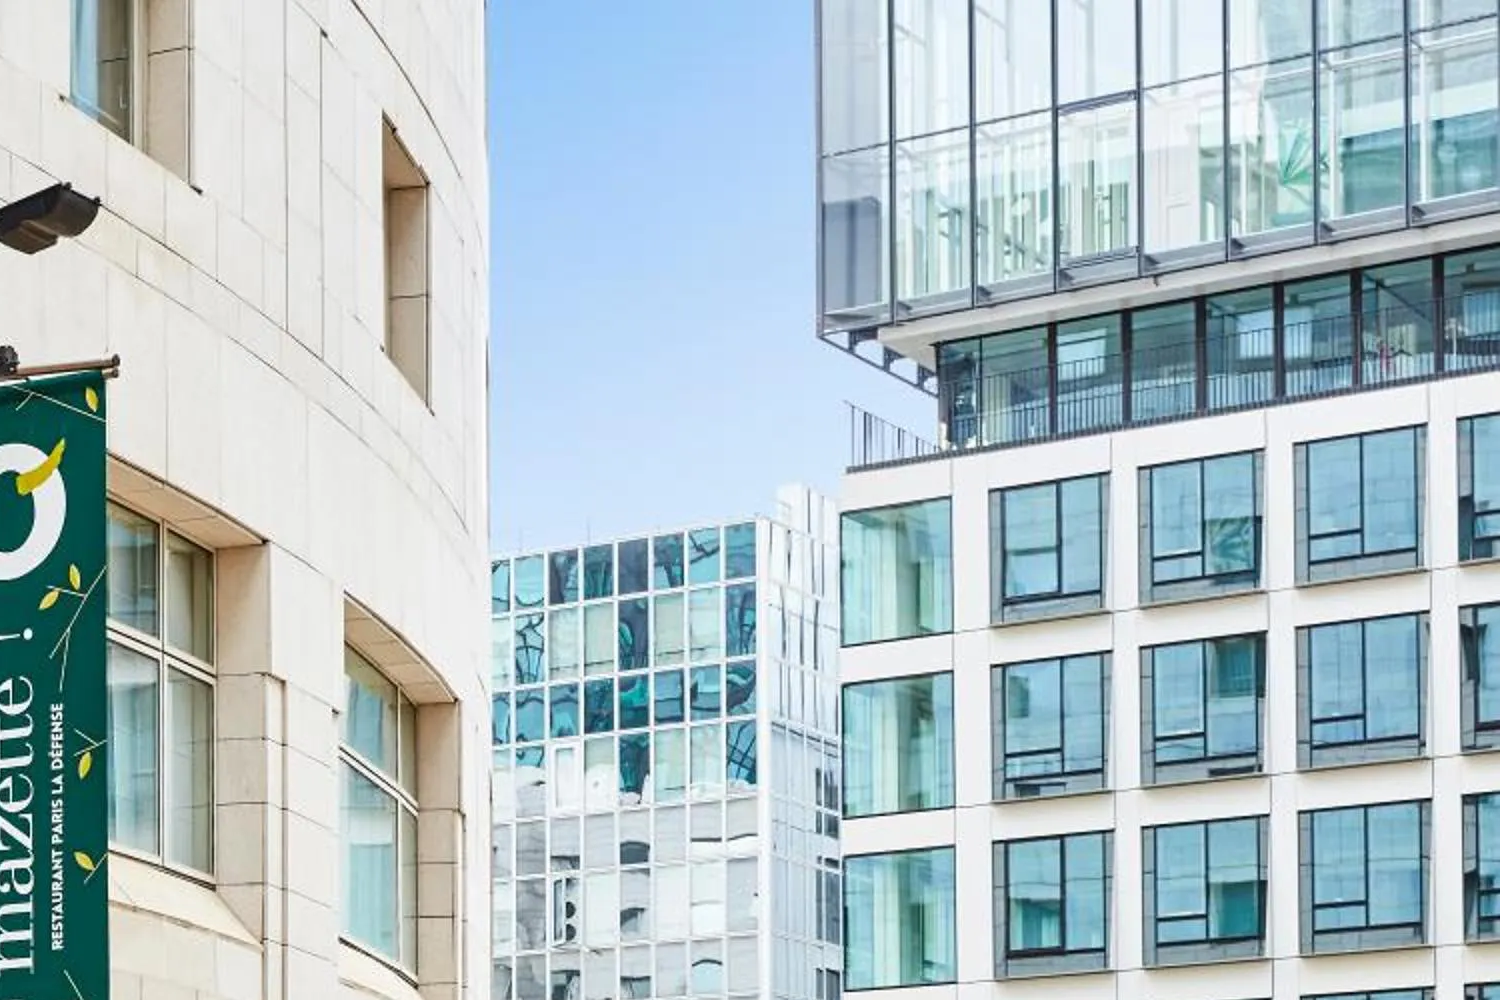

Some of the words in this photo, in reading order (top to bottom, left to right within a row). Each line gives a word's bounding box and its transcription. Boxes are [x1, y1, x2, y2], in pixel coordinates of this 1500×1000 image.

[48, 703, 64, 770] DÉFENSE
[51, 774, 63, 795] LA
[51, 799, 64, 845] PARIS
[51, 849, 64, 951] RESTAURANT
